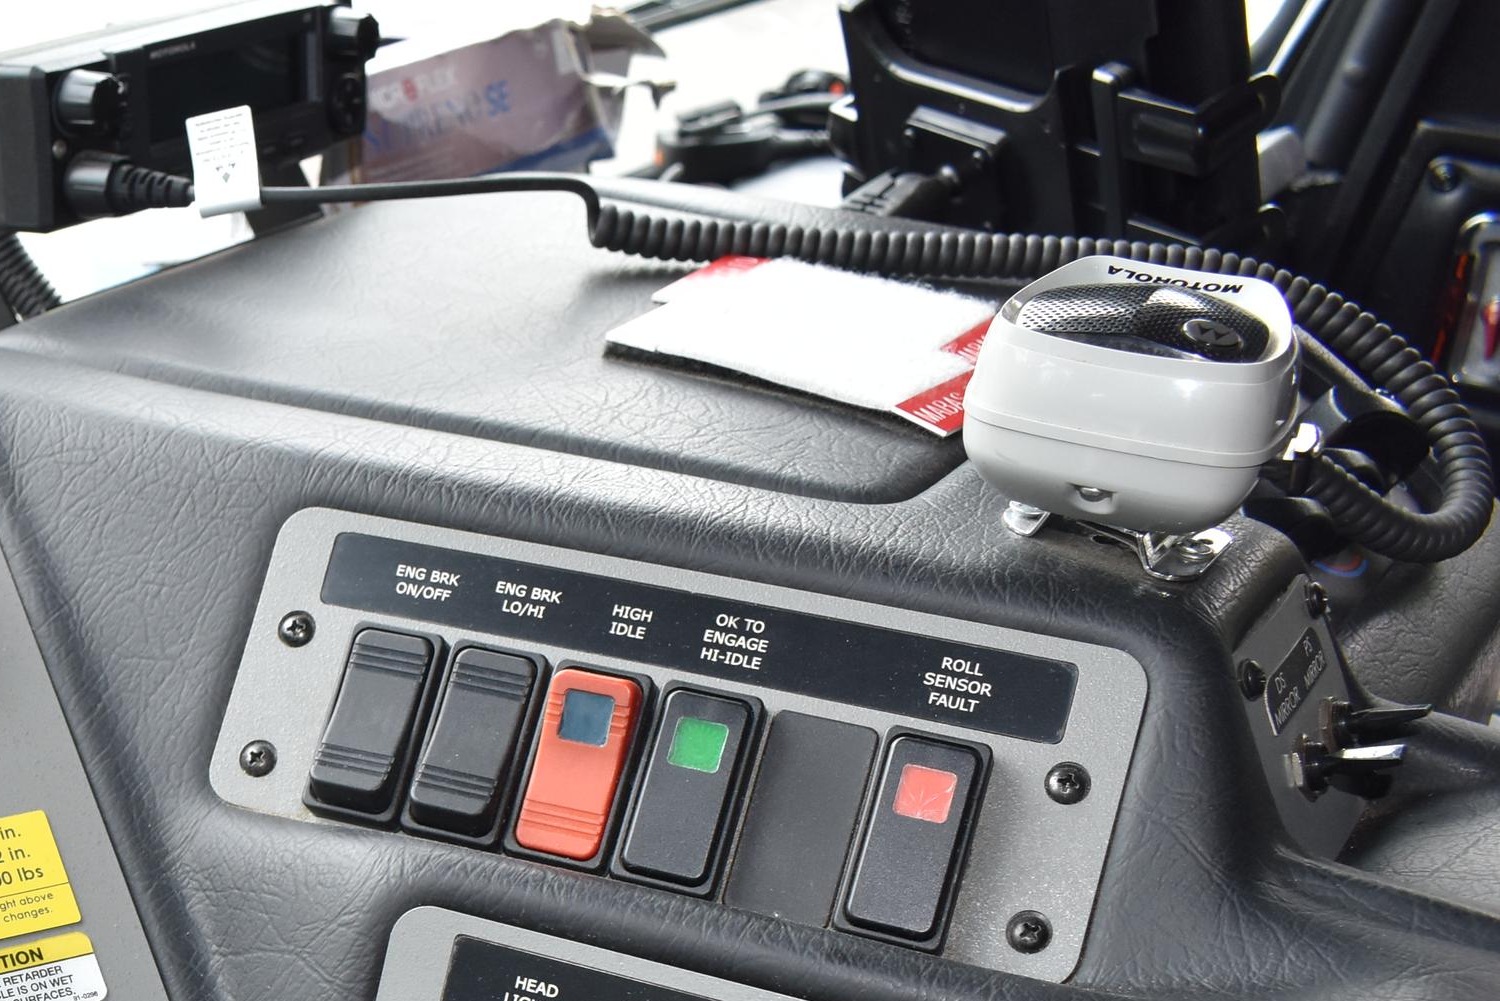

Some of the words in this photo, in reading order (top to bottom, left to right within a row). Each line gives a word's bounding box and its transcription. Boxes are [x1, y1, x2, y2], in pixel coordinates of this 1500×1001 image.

[1108, 264, 1244, 295] MOTOROLA
[396, 564, 426, 582] ENG
[430, 570, 460, 587] BRK
[395, 581, 451, 602] ON/OFF
[495, 581, 526, 598] ENG
[530, 586, 563, 605] BRK
[502, 600, 546, 620] LO/HI
[612, 604, 653, 623] HIGH
[609, 621, 647, 640] IDLE
[715, 613, 742, 630] OK
[744, 618, 765, 634] TO
[703, 629, 769, 654] ENGAGE
[700, 647, 762, 671] HI-IDLE
[941, 656, 983, 677] ROLL
[923, 671, 992, 697] SENSOR
[928, 692, 979, 714] FAULT
[0, 827, 21, 840] in.
[9, 848, 30, 861] in.
[17, 866, 44, 882] lbs
[20, 892, 54, 907] above
[4, 906, 53, 924] changes.
[3, 965, 62, 988] RETARDER
[17, 983, 29, 995] IS
[31, 980, 48, 993] ON
[50, 974, 74, 988] WET
[515, 976, 559, 998] HEAD
